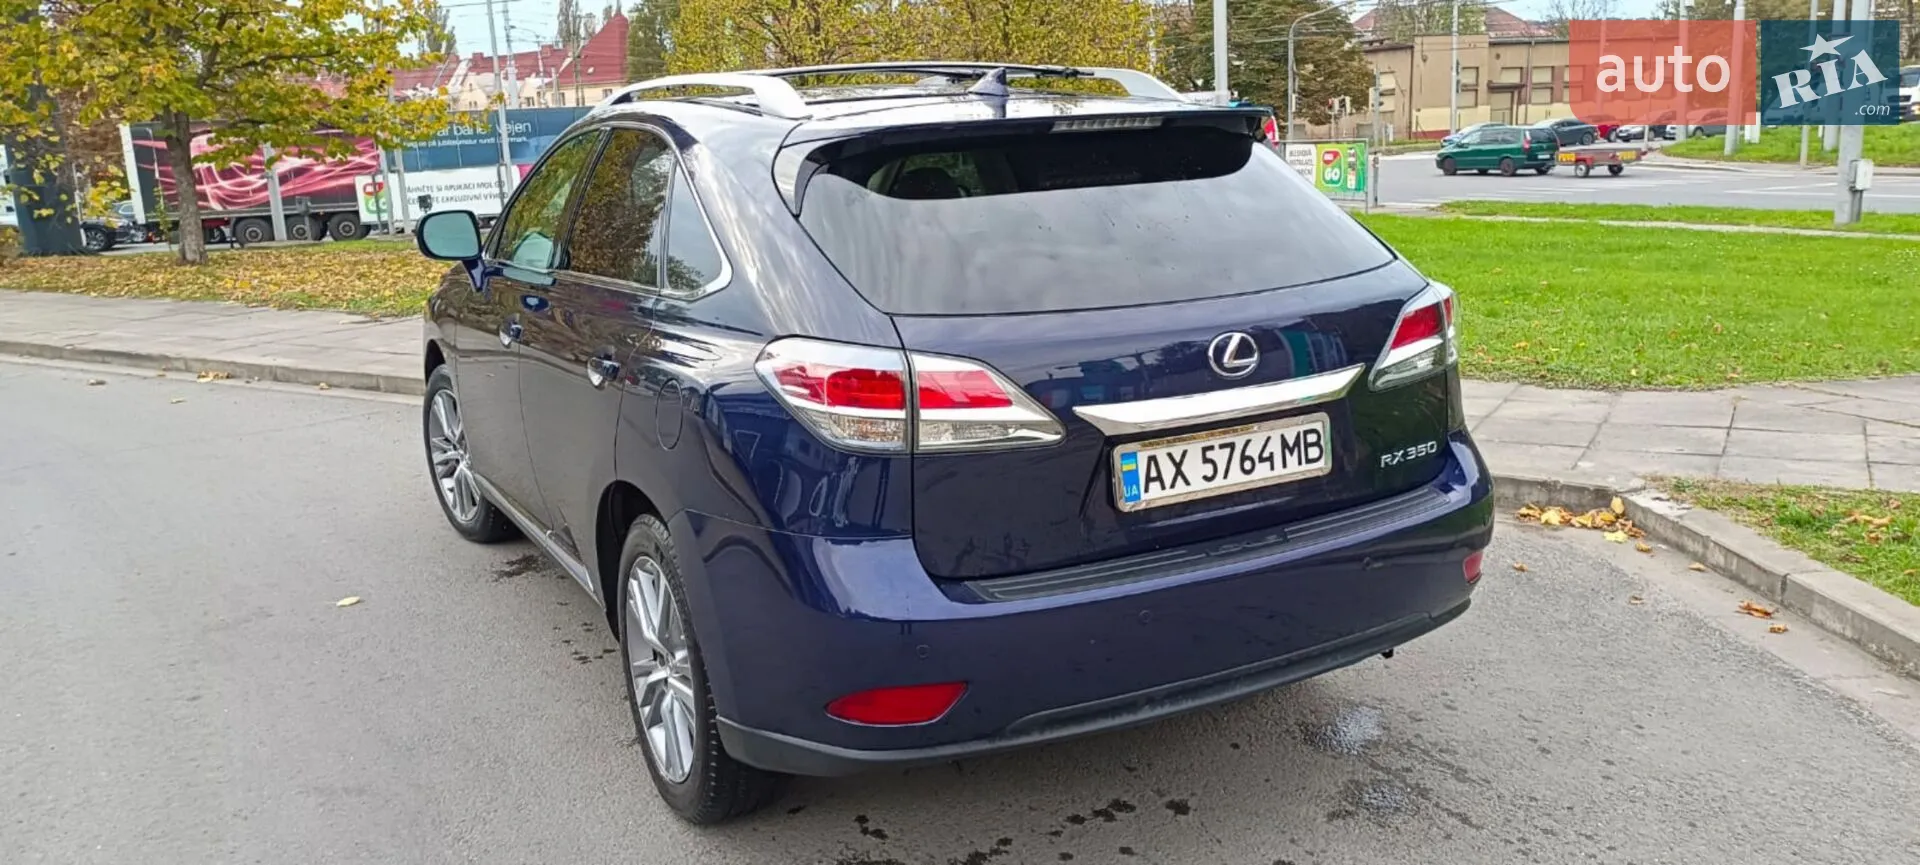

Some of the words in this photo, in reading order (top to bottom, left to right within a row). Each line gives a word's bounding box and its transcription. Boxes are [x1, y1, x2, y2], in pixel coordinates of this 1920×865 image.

[1324, 167, 1341, 181] GO
[1144, 448, 1191, 494] AX
[1201, 435, 1275, 483] 5764
[1280, 428, 1325, 470] MB
[1123, 486, 1139, 498] UA
